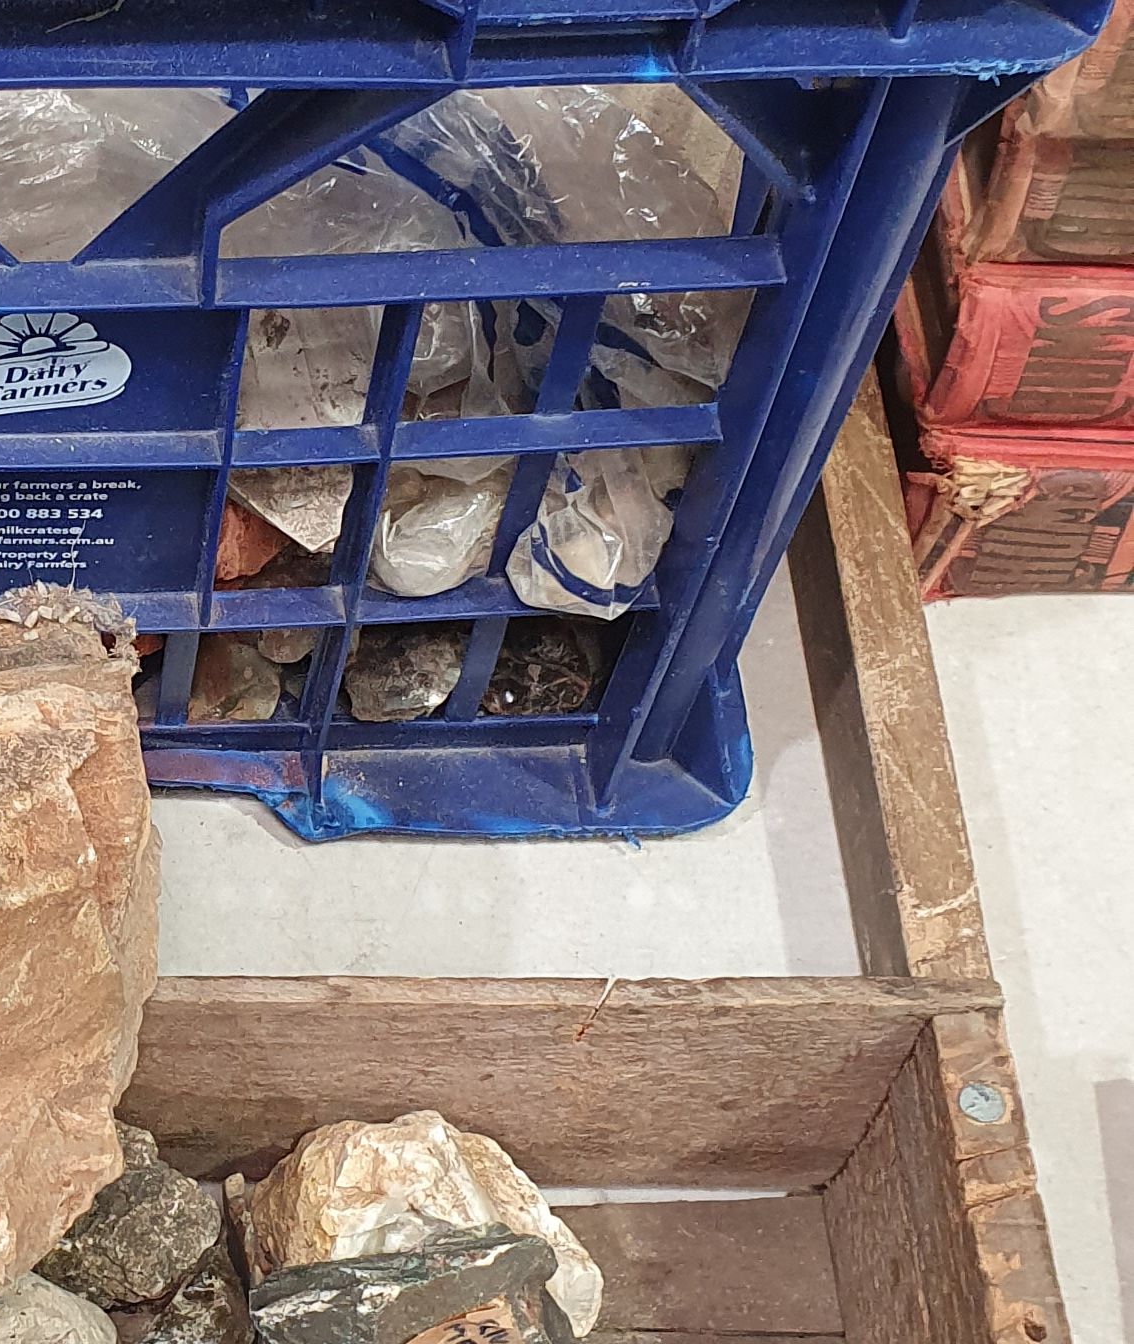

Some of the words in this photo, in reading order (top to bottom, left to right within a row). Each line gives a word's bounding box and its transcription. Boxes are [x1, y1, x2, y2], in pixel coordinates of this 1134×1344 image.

[4, 356, 92, 385] Dairy
[14, 480, 74, 490] farmers
[77, 481, 88, 490] a
[92, 480, 142, 490] break,
[16, 491, 51, 501] back
[55, 493, 65, 501] a
[69, 492, 109, 501] crate
[25, 508, 61, 519] 883
[67, 508, 104, 519] 534
[61, 550, 79, 559] of
[27, 560, 87, 569] Farmers
